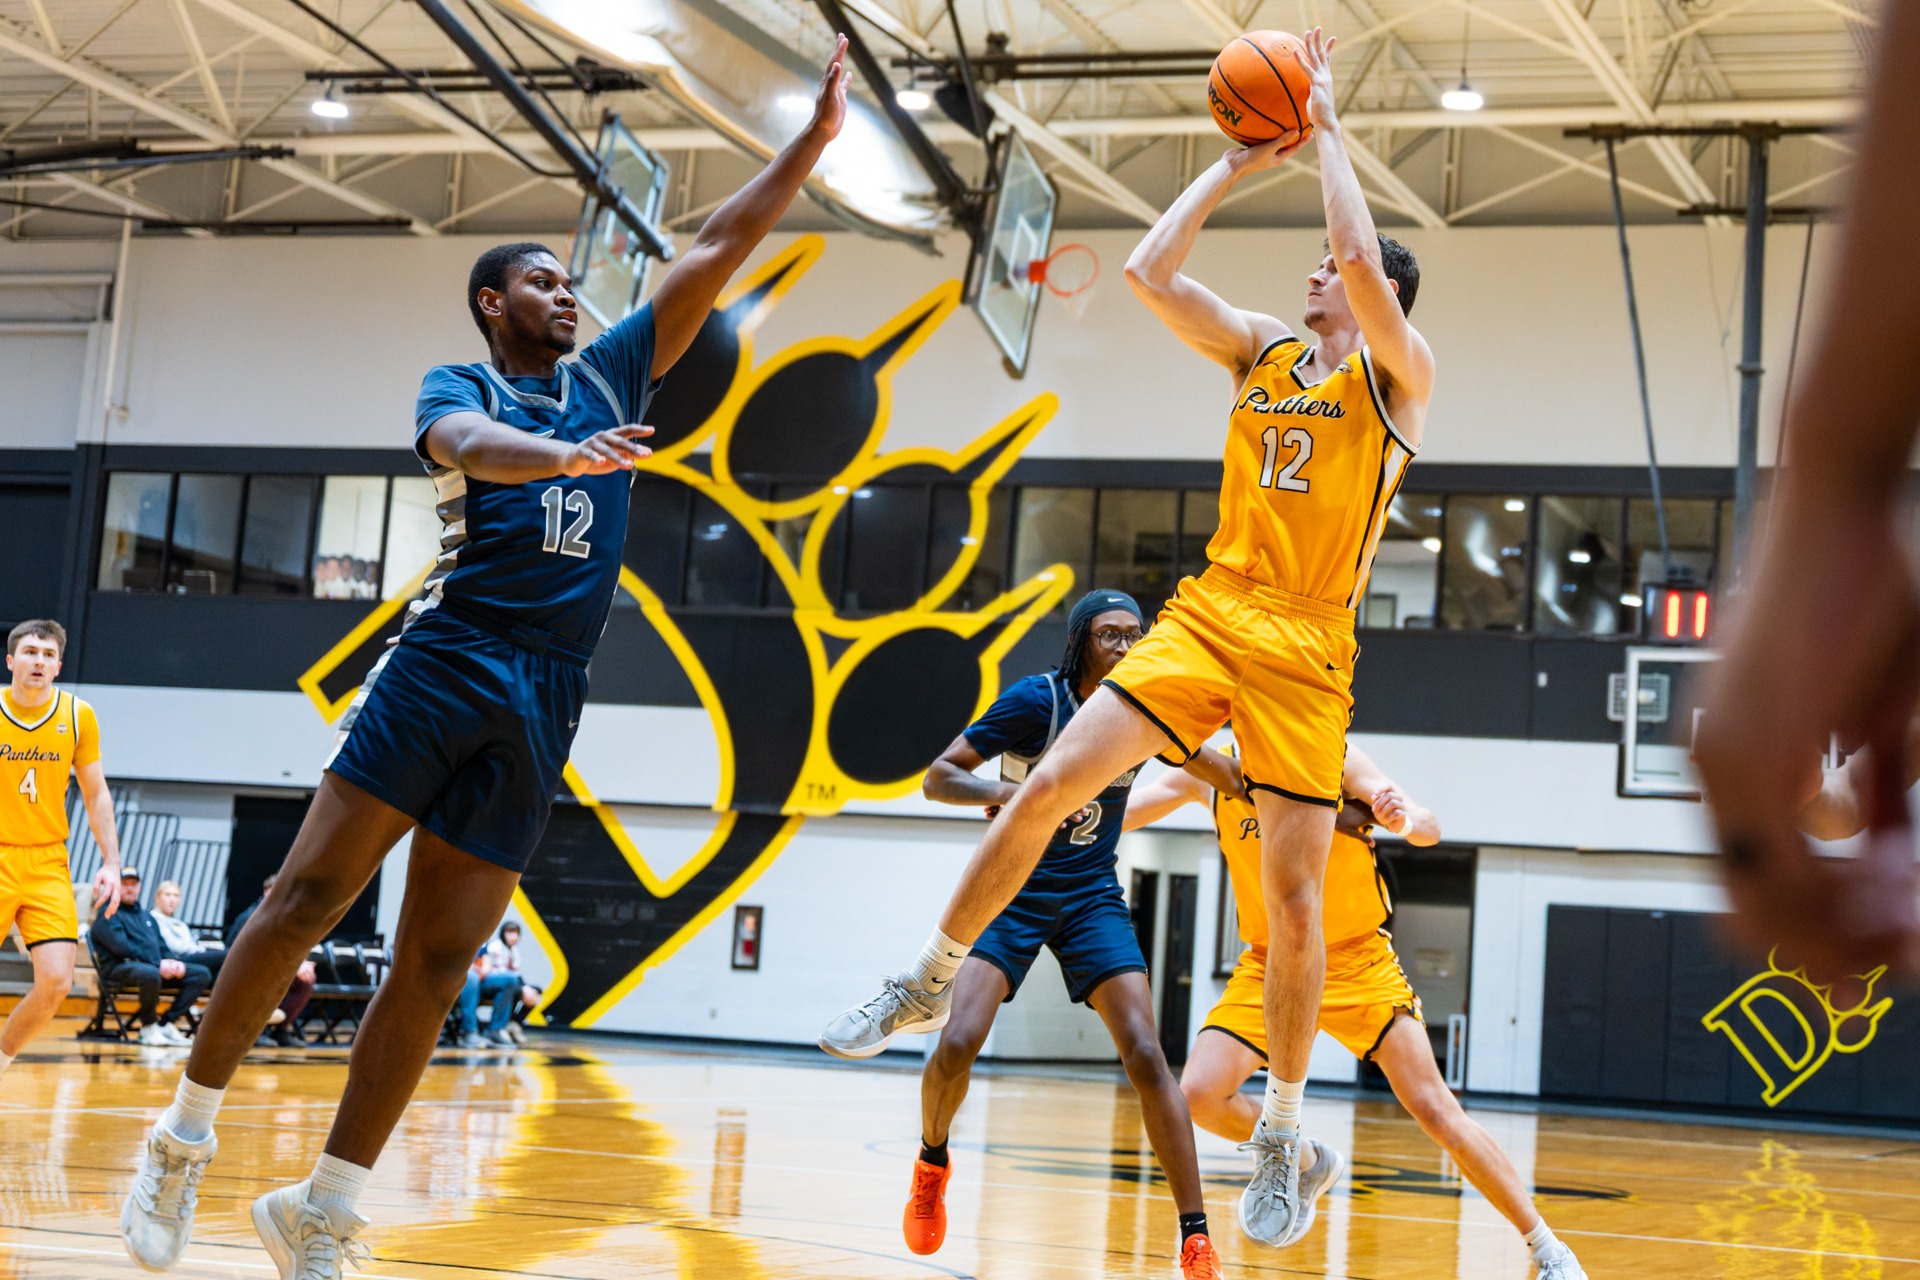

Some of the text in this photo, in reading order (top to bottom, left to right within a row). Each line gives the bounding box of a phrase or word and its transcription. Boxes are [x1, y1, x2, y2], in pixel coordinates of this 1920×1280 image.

[1207, 81, 1243, 127] NCAA
[1238, 385, 1346, 419] Panthers
[1259, 425, 1314, 494] 12
[541, 485, 594, 559] 12
[1664, 590, 1708, 639] 11
[0, 743, 61, 762] Panthers
[18, 766, 38, 804] 4
[805, 782, 837, 801] TM
